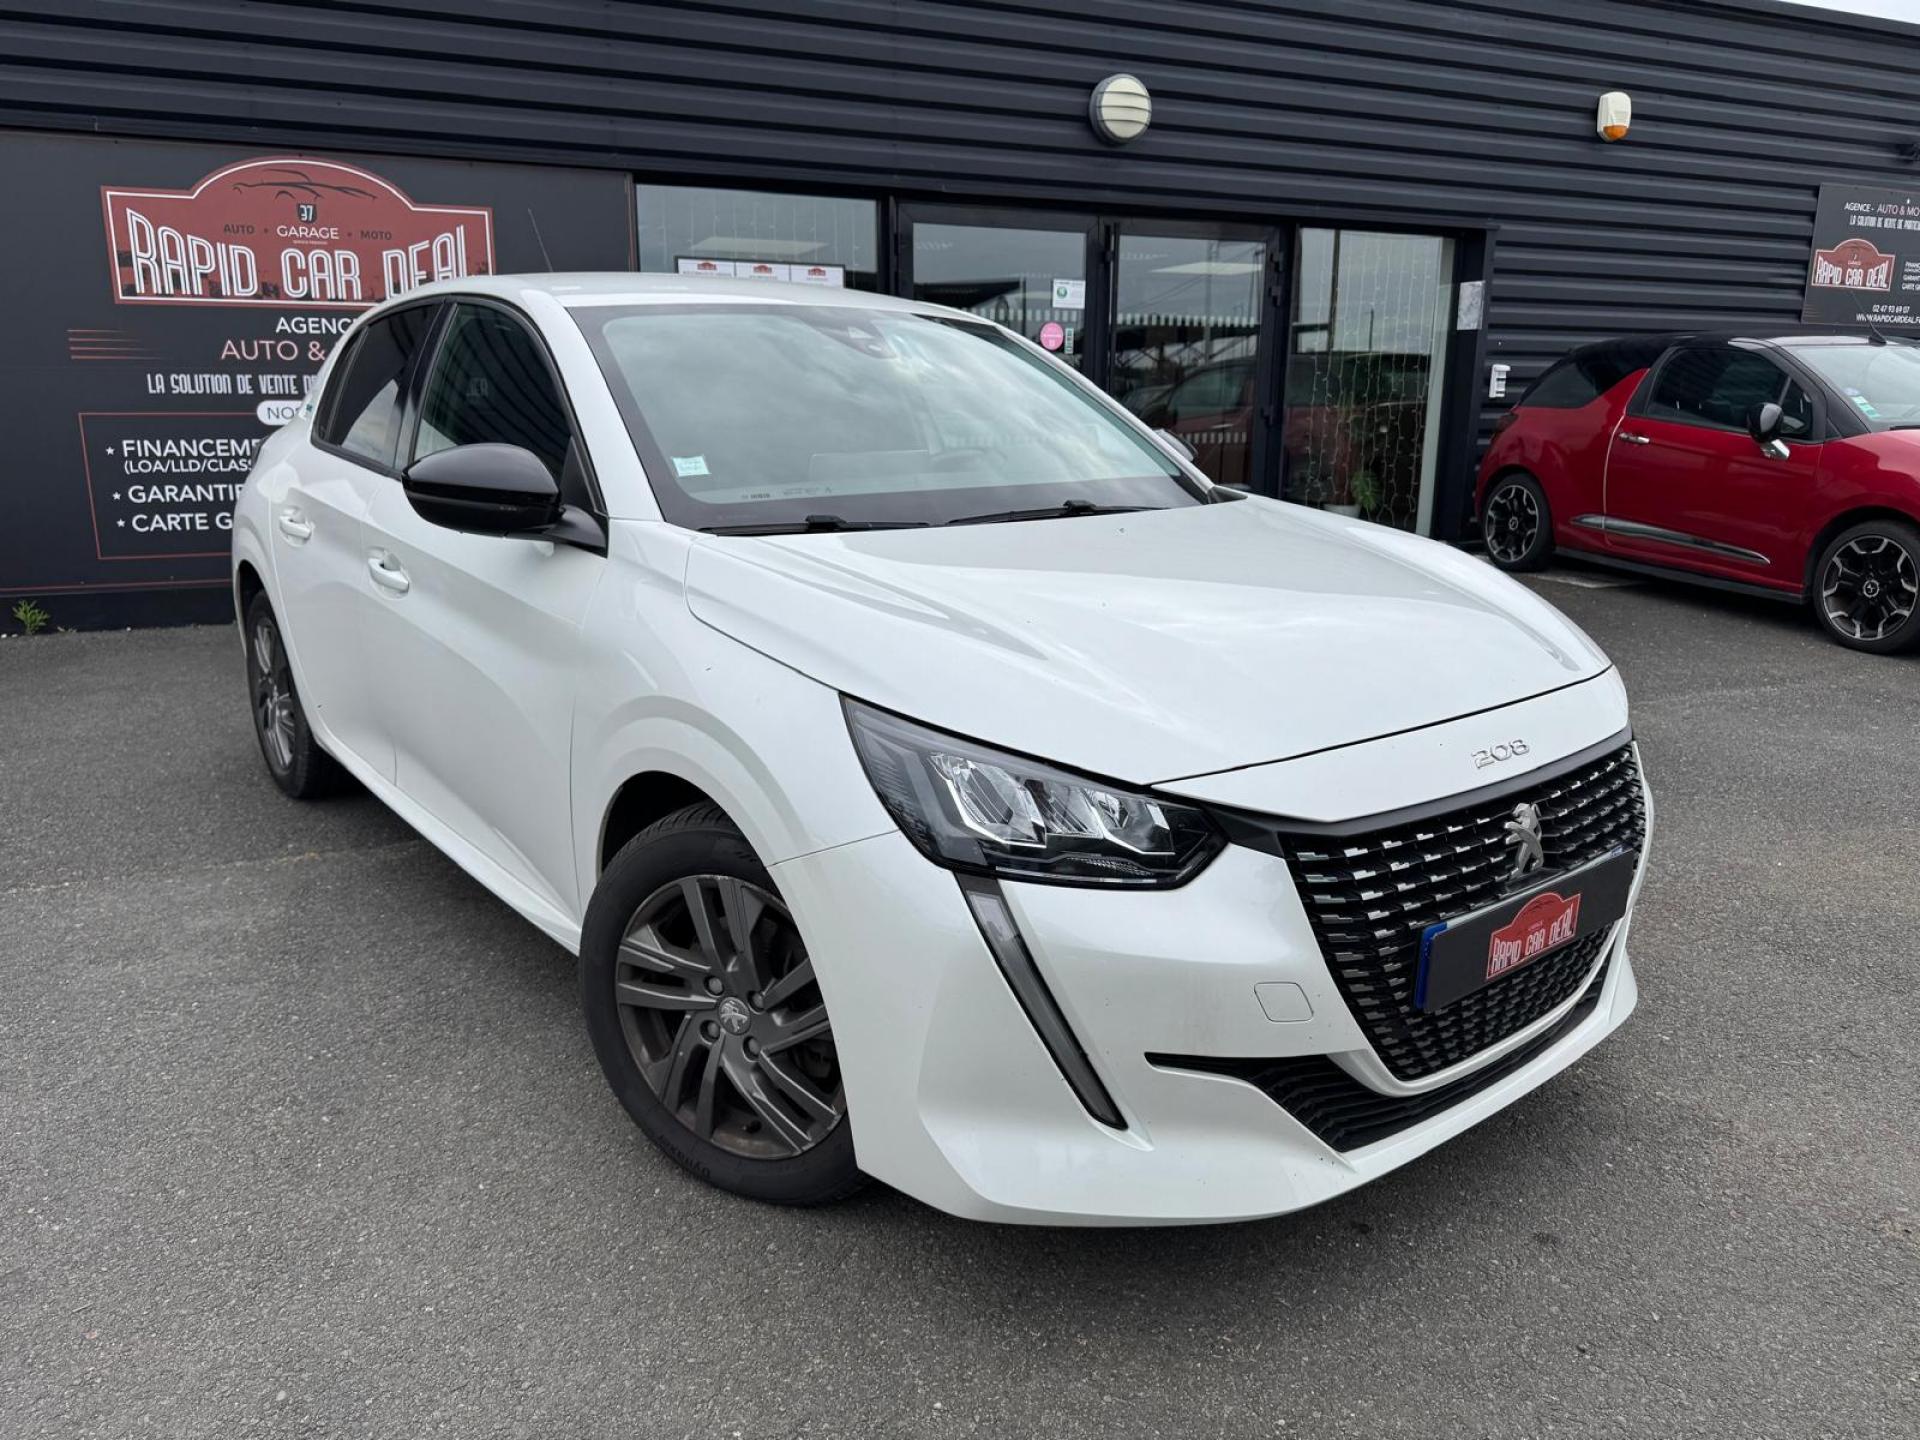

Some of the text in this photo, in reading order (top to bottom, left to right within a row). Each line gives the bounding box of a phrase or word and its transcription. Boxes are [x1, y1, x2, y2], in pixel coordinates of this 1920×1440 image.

[1877, 204, 1899, 215] AUTO
[223, 223, 392, 241] AUTO GARAGE MOTO
[126, 207, 258, 296] RAPID
[281, 247, 362, 300] CAR
[1815, 255, 1888, 288] RAPID CAR DEAL
[275, 317, 358, 334] AGENC
[220, 340, 326, 361] AUTO &
[147, 374, 165, 394] LA
[170, 373, 232, 394] SOLUTION
[237, 374, 254, 394] DE
[258, 374, 299, 395] VENTE
[131, 513, 209, 532] CARTE
[1471, 739, 1530, 769] 208
[1491, 902, 1574, 974] RAPID CAR DEAL
